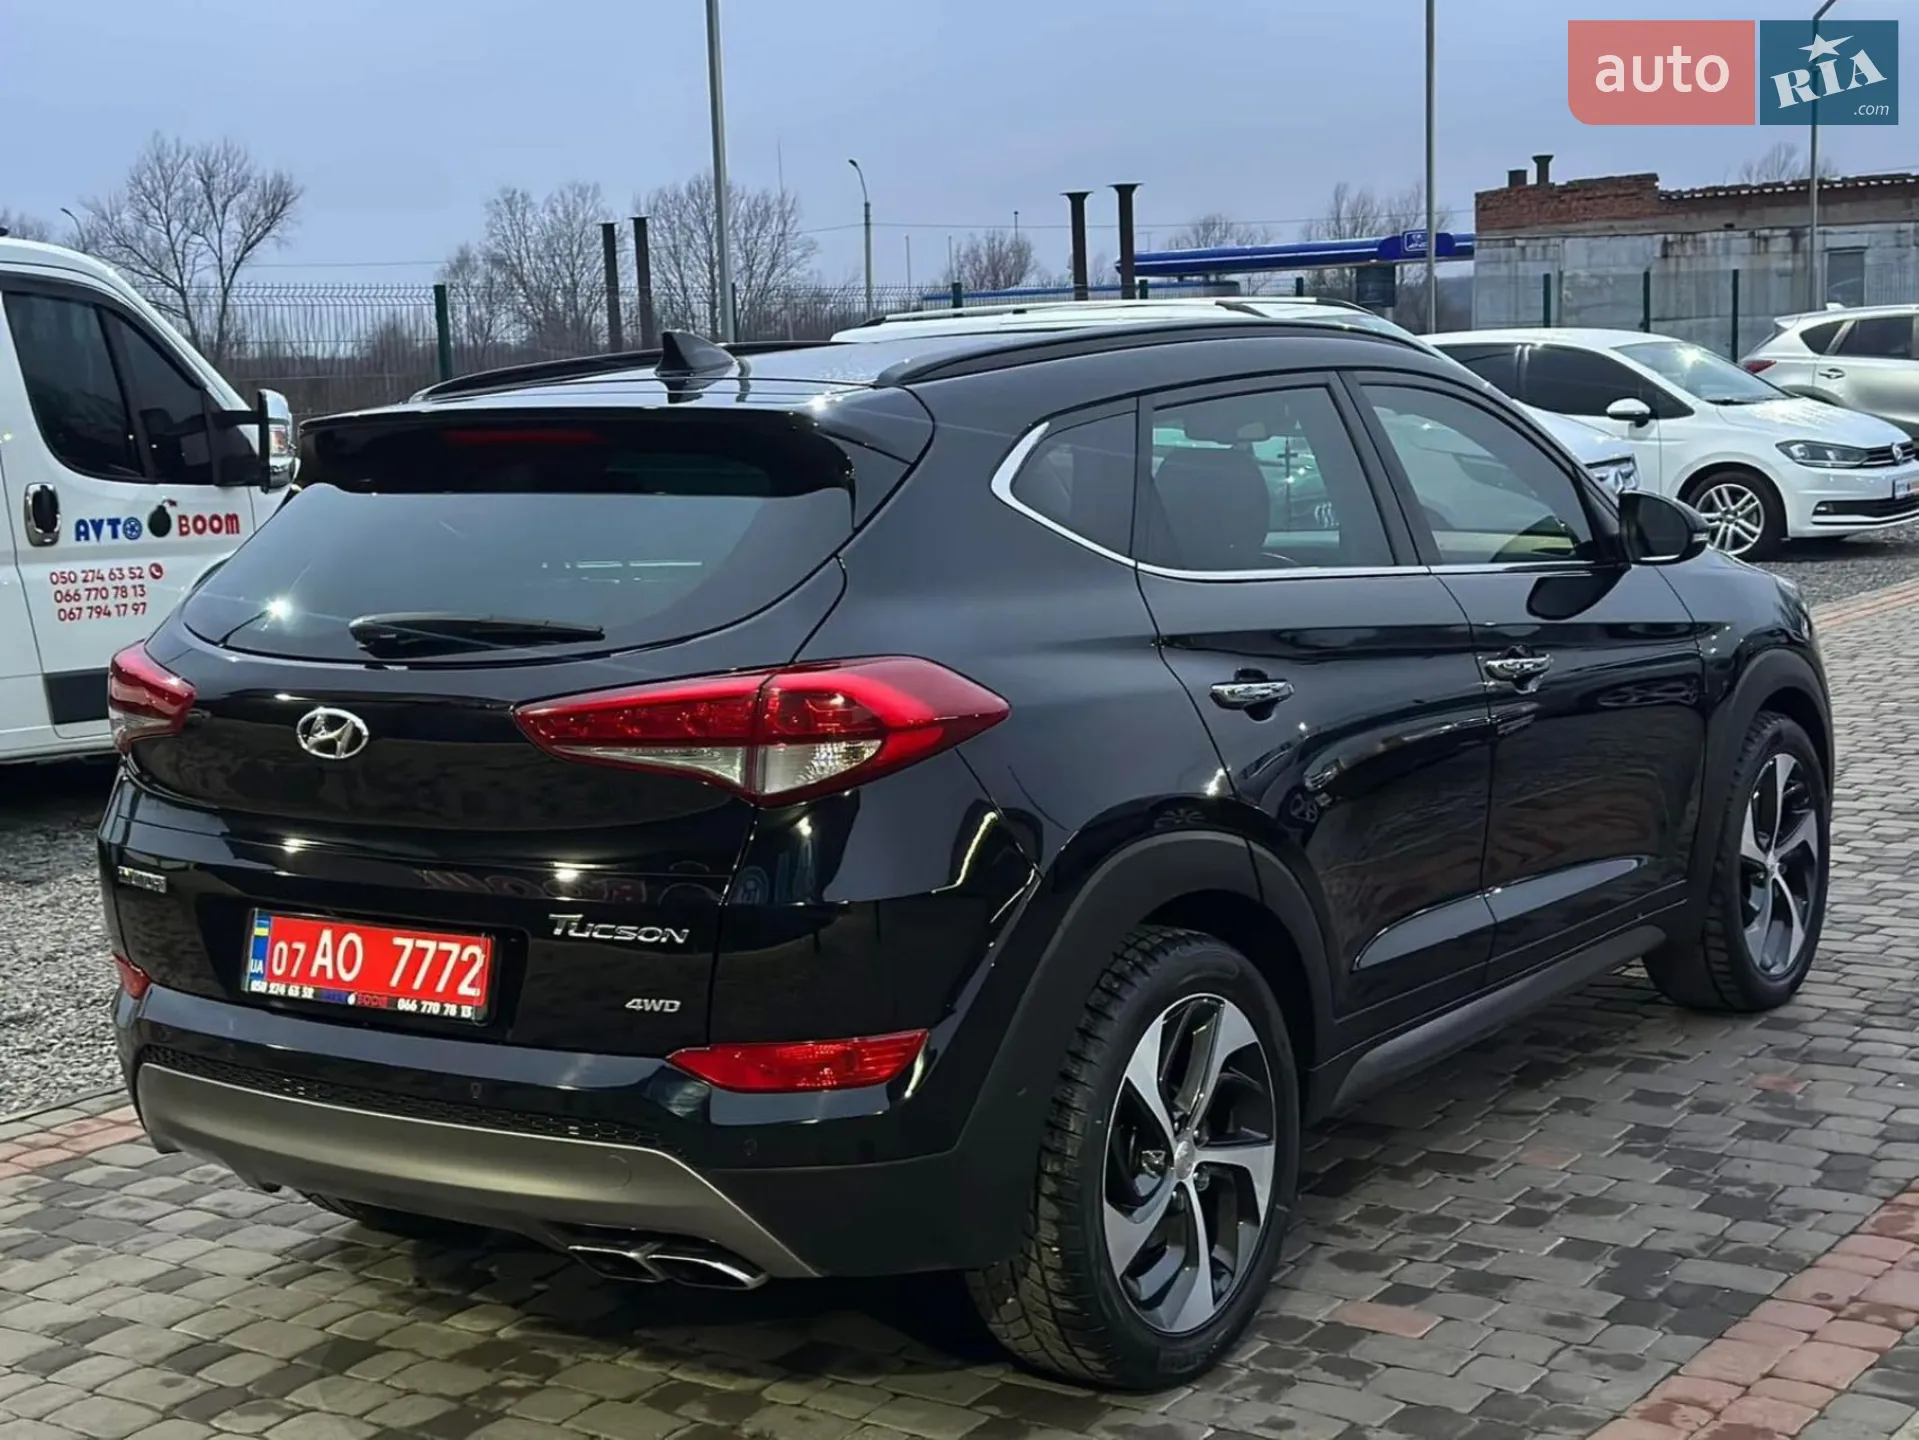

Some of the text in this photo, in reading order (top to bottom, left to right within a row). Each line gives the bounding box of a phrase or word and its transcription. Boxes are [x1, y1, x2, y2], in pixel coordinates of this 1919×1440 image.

[178, 513, 240, 537] BOOM
[50, 566, 145, 585] 050 274 63 52
[54, 584, 146, 603] 066 770 78 13
[57, 602, 147, 622] 067 794 17 97
[250, 958, 264, 974] UA
[271, 928, 486, 997] 07 AO 7772
[624, 998, 681, 1012] 4WD
